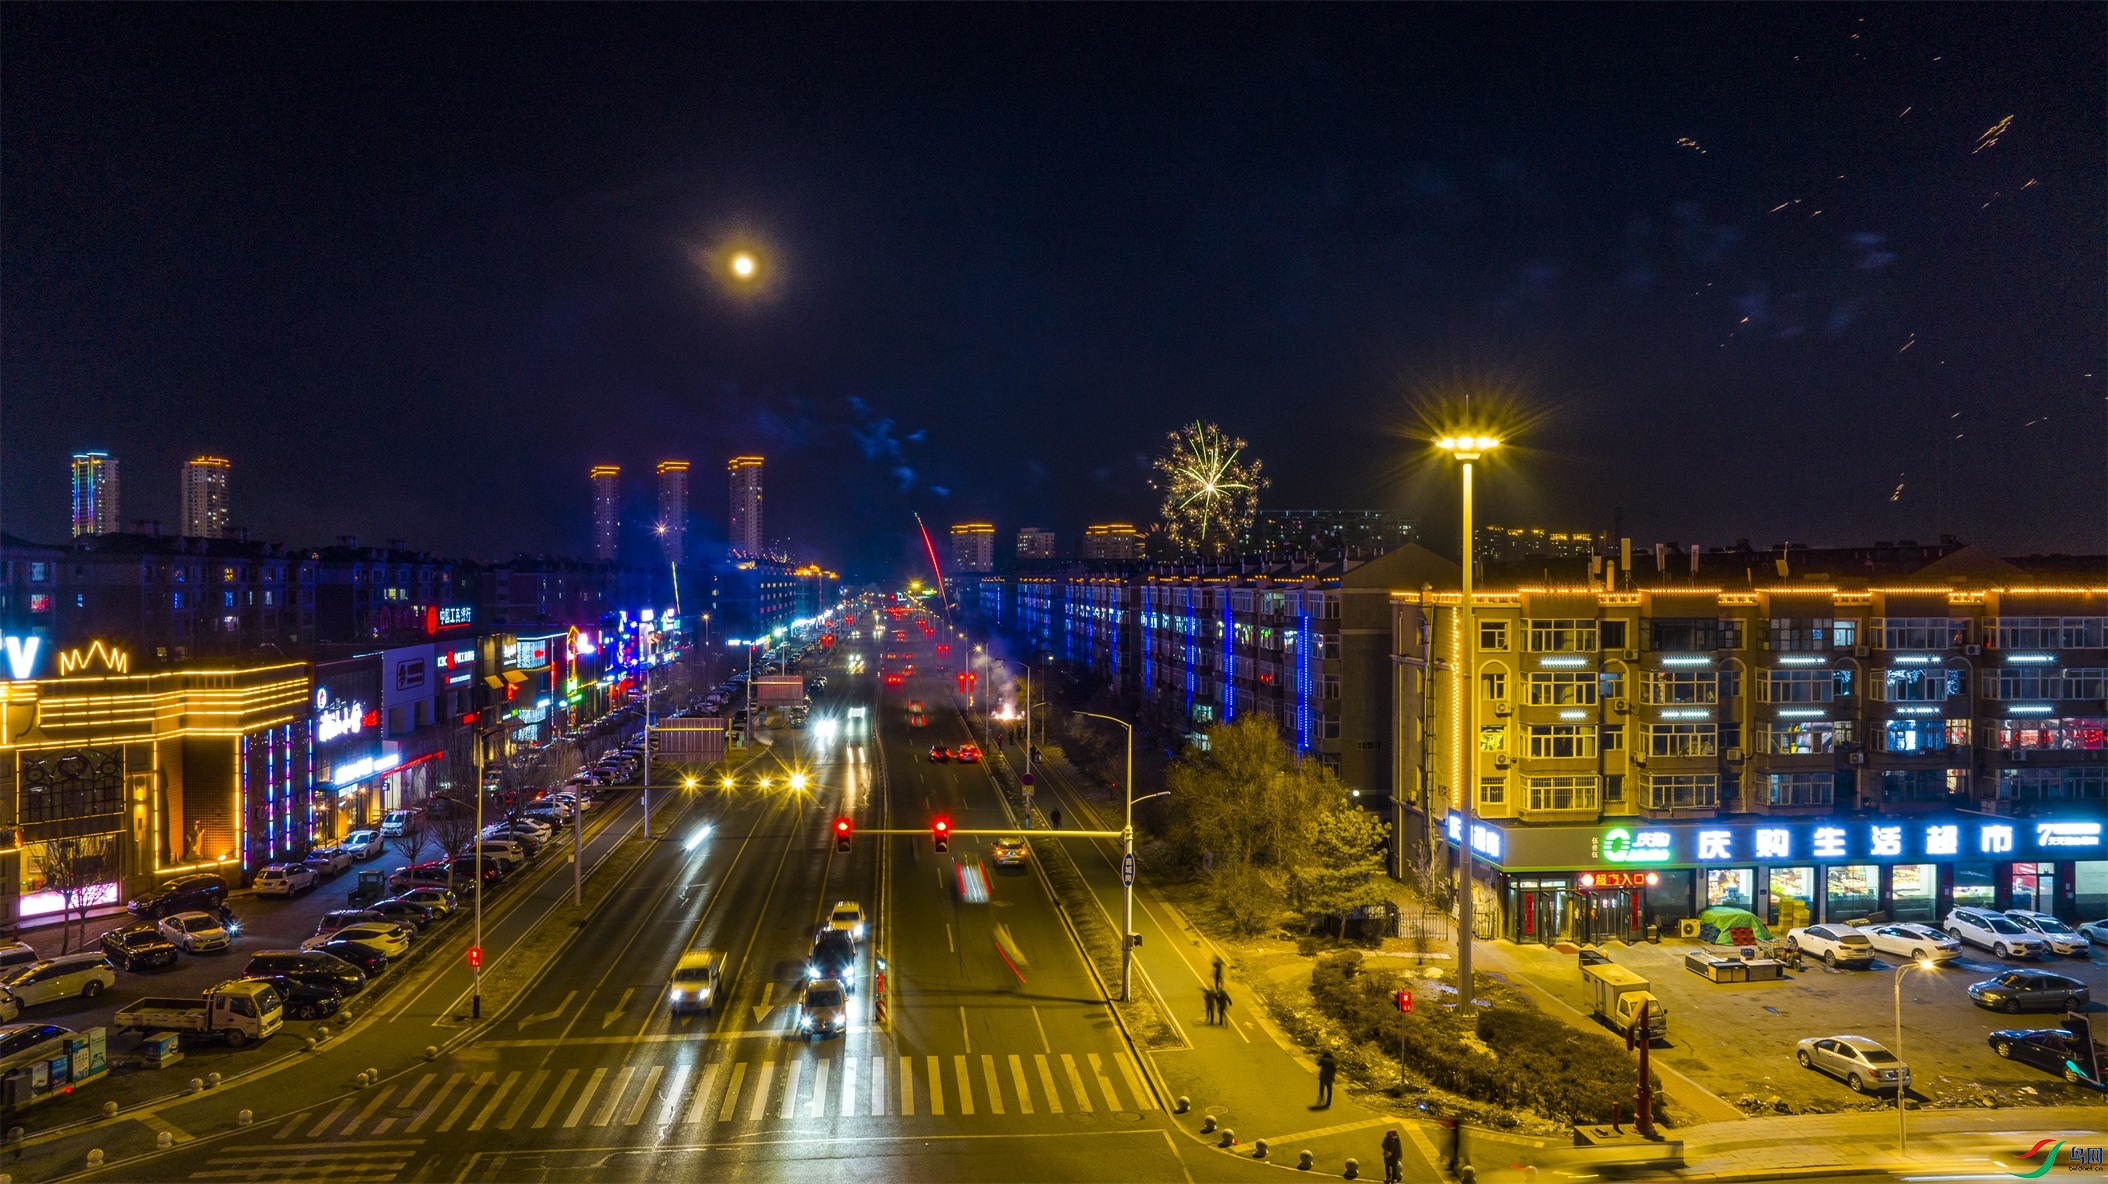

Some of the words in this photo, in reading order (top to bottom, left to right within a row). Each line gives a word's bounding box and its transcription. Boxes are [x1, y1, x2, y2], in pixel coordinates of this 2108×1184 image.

[440, 607, 471, 625] 中国工商银行
[0, 635, 39, 679] V
[1449, 816, 1499, 857] 庆超市
[1698, 825, 2012, 859] 庆购生活超市
